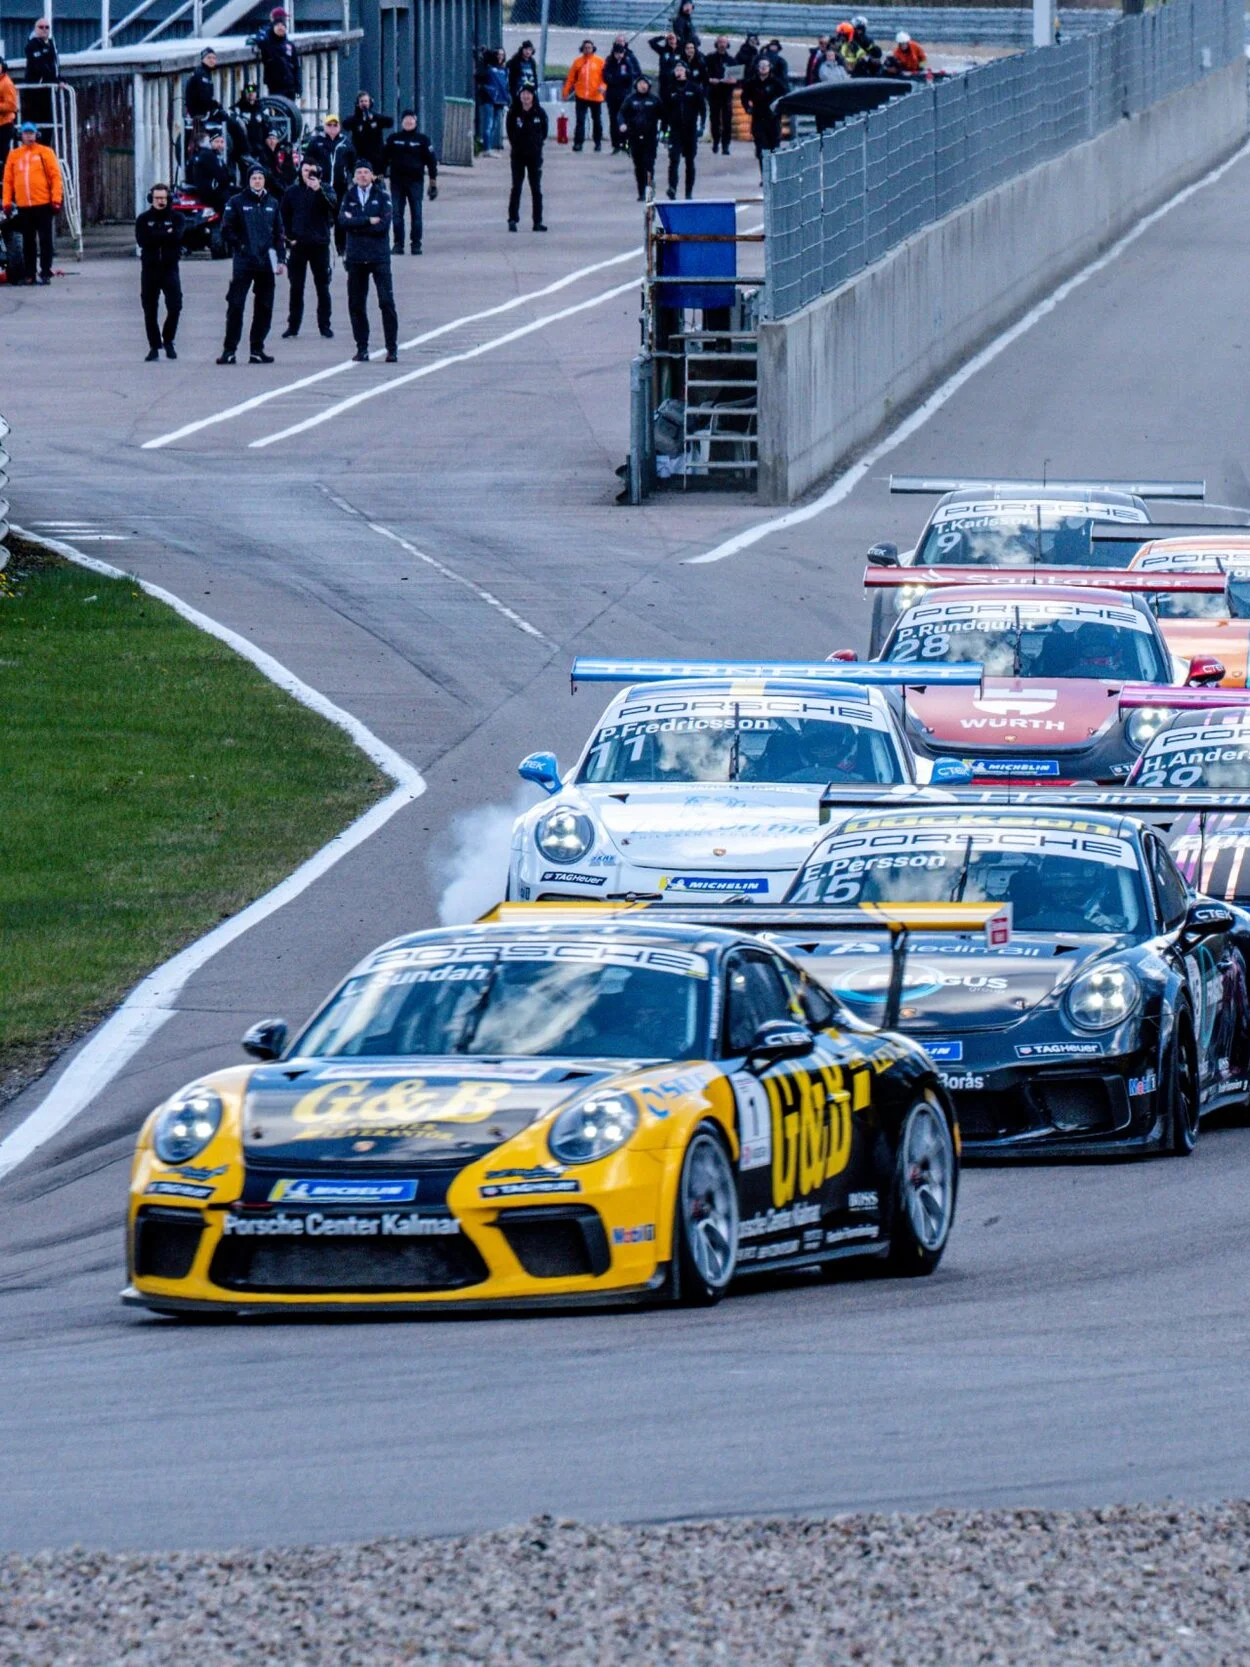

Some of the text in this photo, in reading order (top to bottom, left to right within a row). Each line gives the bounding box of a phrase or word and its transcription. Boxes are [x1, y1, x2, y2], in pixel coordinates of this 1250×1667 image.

[943, 503, 1141, 521] PORSCHE
[936, 532, 961, 555] 9
[965, 574, 1190, 587] Santander
[912, 604, 1138, 624] PORSCHE
[892, 633, 950, 663] 28
[618, 701, 873, 722] PORSCHE
[600, 716, 769, 742] P.Fredricsson
[590, 735, 647, 769] 11
[988, 763, 1049, 772] MICHELIN
[978, 792, 1250, 805] Hedin Bil
[829, 834, 1123, 858] PORSCHE
[803, 852, 946, 883] E.Persson
[554, 873, 603, 885] TAGHeuer
[688, 881, 759, 890] MICHELIN
[1195, 909, 1232, 921] CTEK
[370, 944, 700, 974] PORSCHE
[1036, 1044, 1099, 1054] TAGHeuer
[292, 1079, 512, 1124] G&B
[310, 1185, 404, 1196] MICHELIN
[224, 1213, 462, 1236] Porsche Center Kalmar
